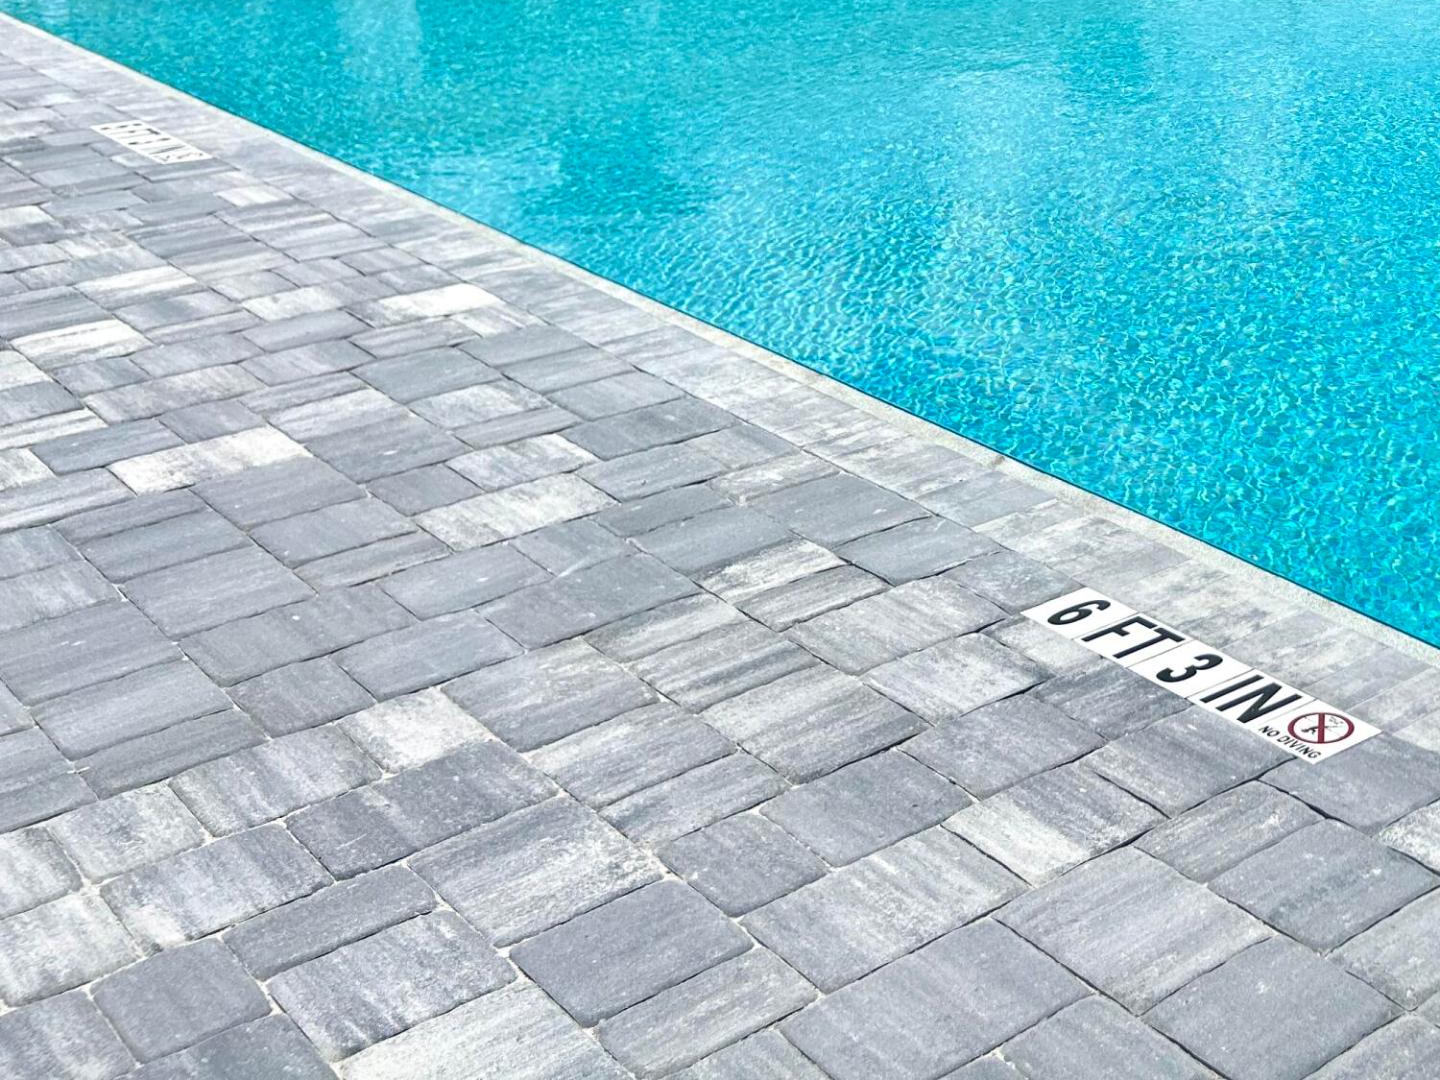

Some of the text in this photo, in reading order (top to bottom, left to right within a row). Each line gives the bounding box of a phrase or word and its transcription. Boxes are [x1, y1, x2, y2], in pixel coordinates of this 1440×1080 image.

[1047, 599, 1303, 724] 6 FT 3 IN
[1259, 725, 1321, 759] NO DIVING
